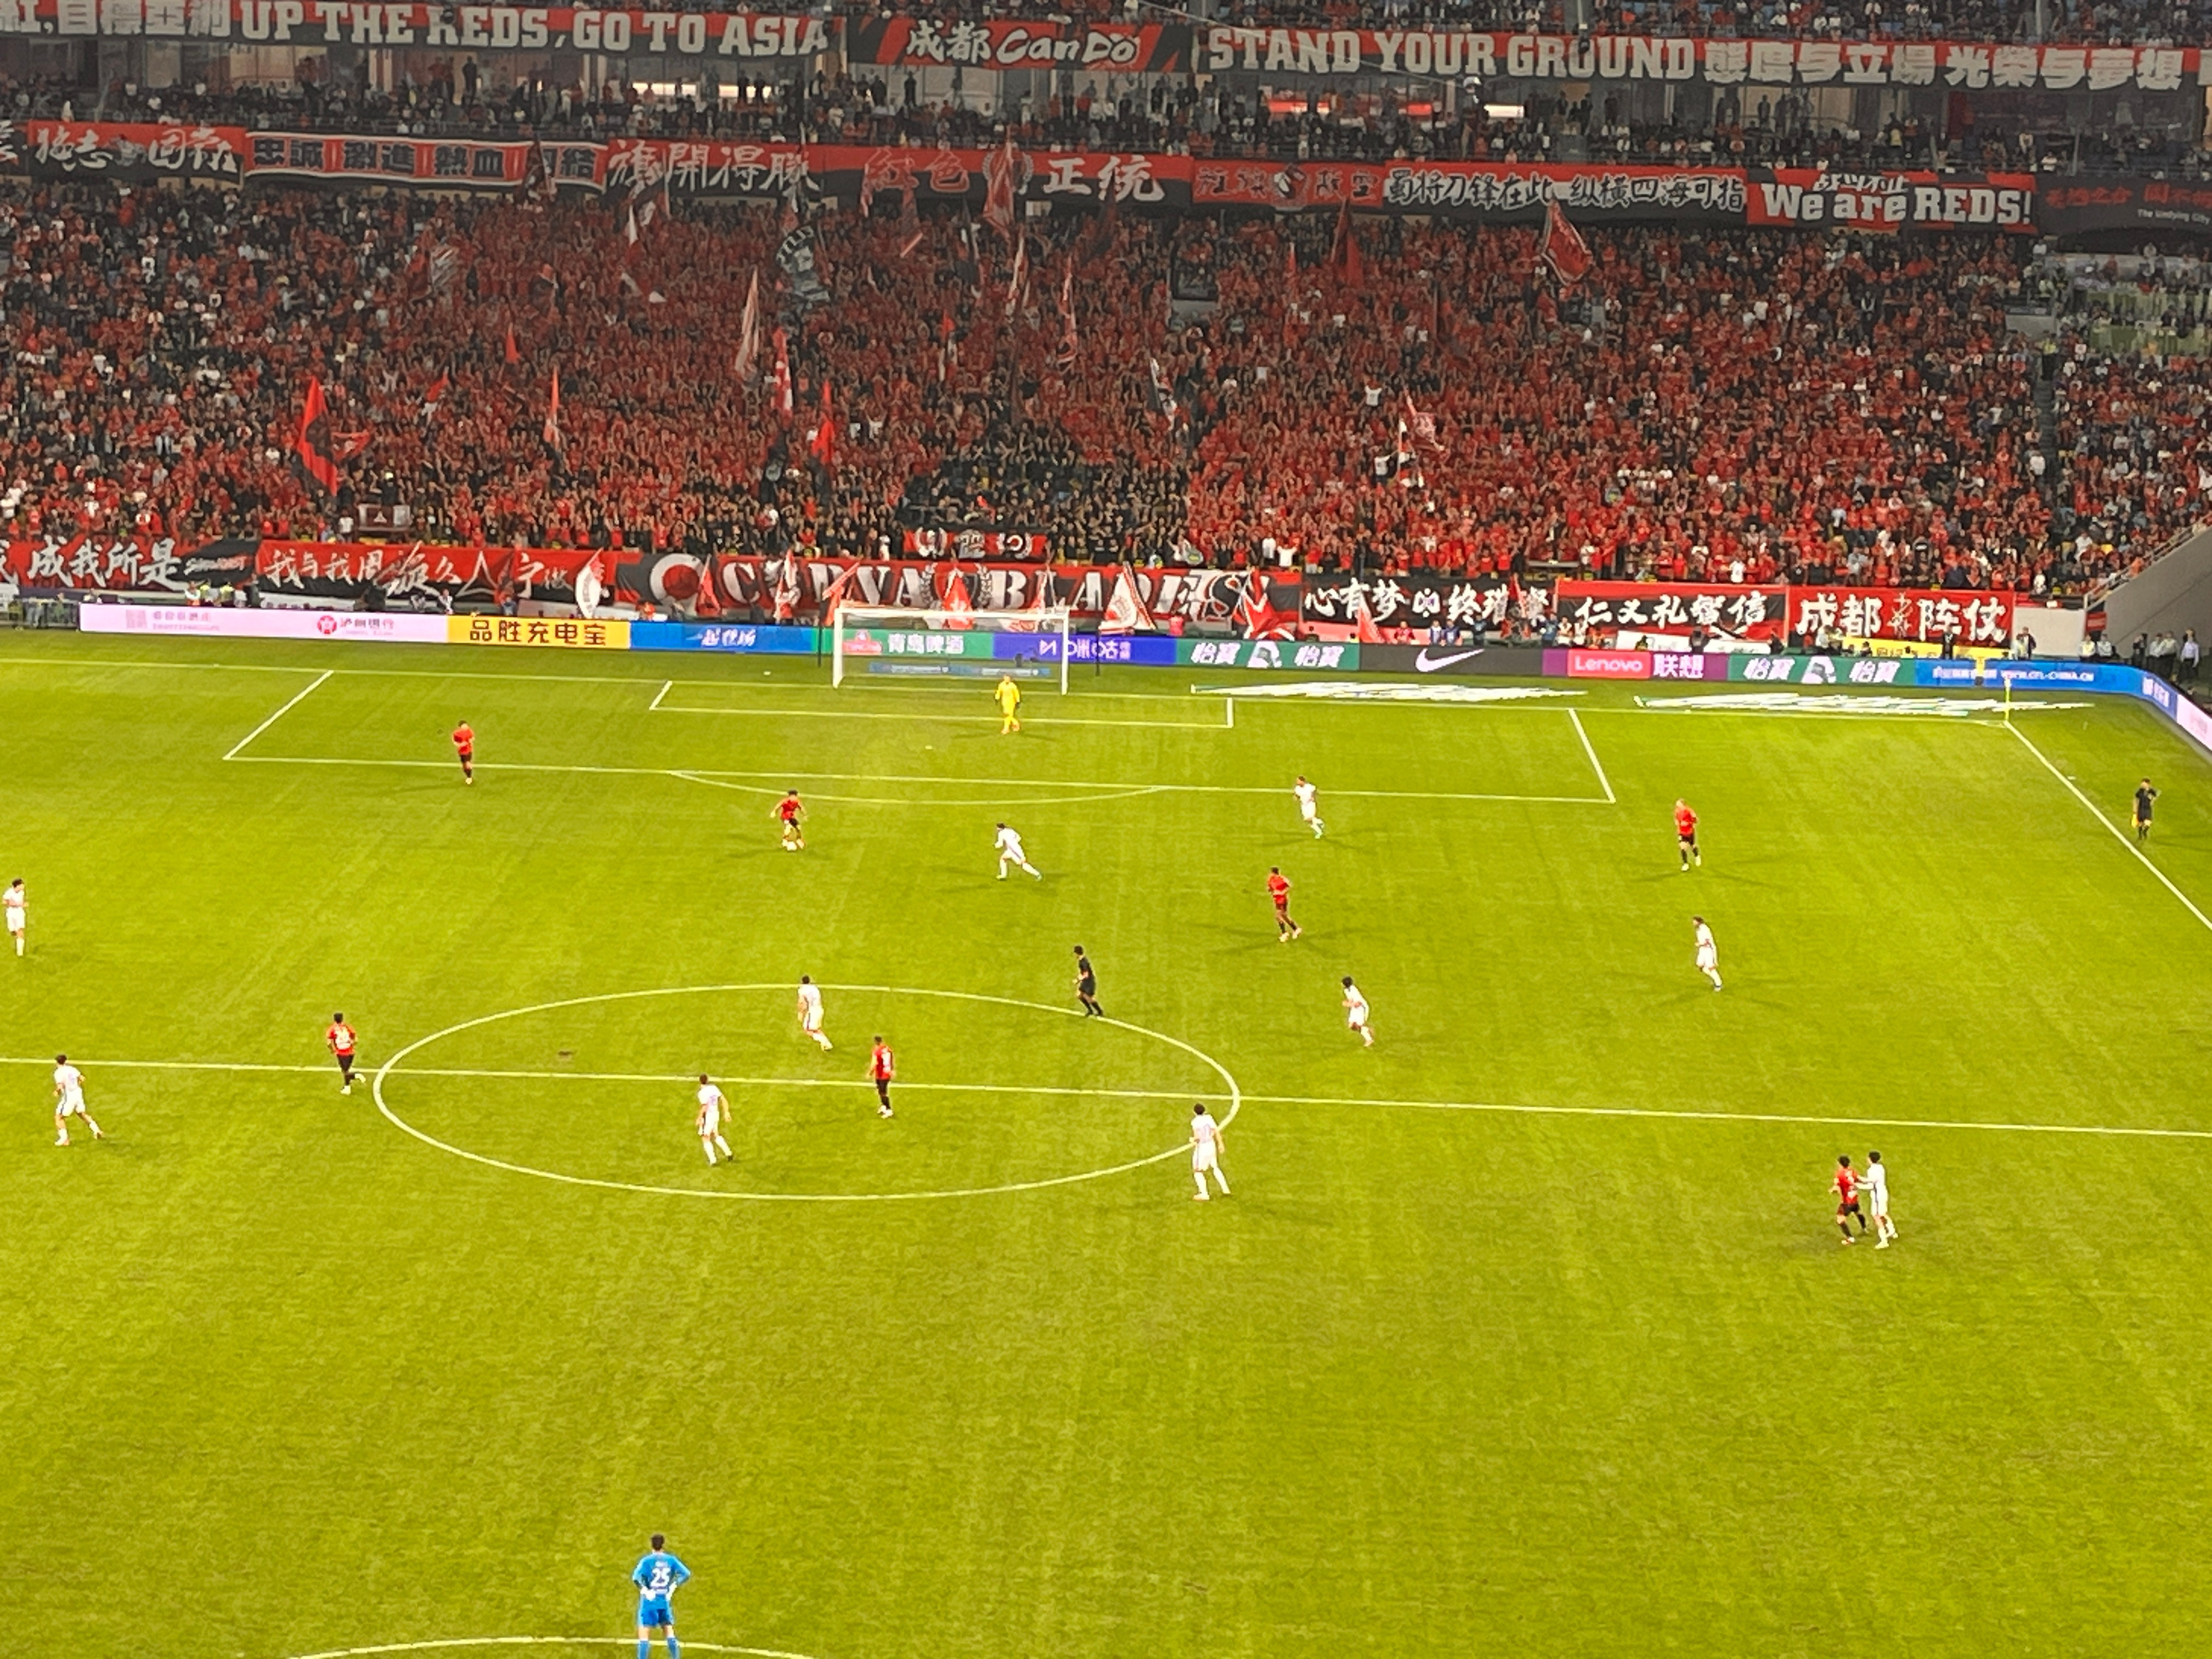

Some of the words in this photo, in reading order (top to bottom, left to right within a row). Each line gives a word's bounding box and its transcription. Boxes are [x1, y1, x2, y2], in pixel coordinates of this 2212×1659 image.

[241, 1, 304, 40] UP
[316, 3, 414, 43] THE
[642, 16, 706, 52] TO
[718, 16, 828, 55] ASIA
[907, 20, 991, 64] 成都
[1209, 29, 1360, 73] STAND
[1378, 33, 1497, 76] YOUR
[1507, 36, 1695, 79] GROUND
[1761, 183, 1825, 220] We
[1833, 193, 1906, 223] are
[1914, 186, 2031, 224] REDS!
[469, 619, 607, 646] 品胜充电宝
[888, 633, 964, 654] 青岛啤酒
[1575, 656, 1643, 673] Lenovo
[1653, 654, 1705, 678] 联想
[650, 1567, 670, 1587] 25
